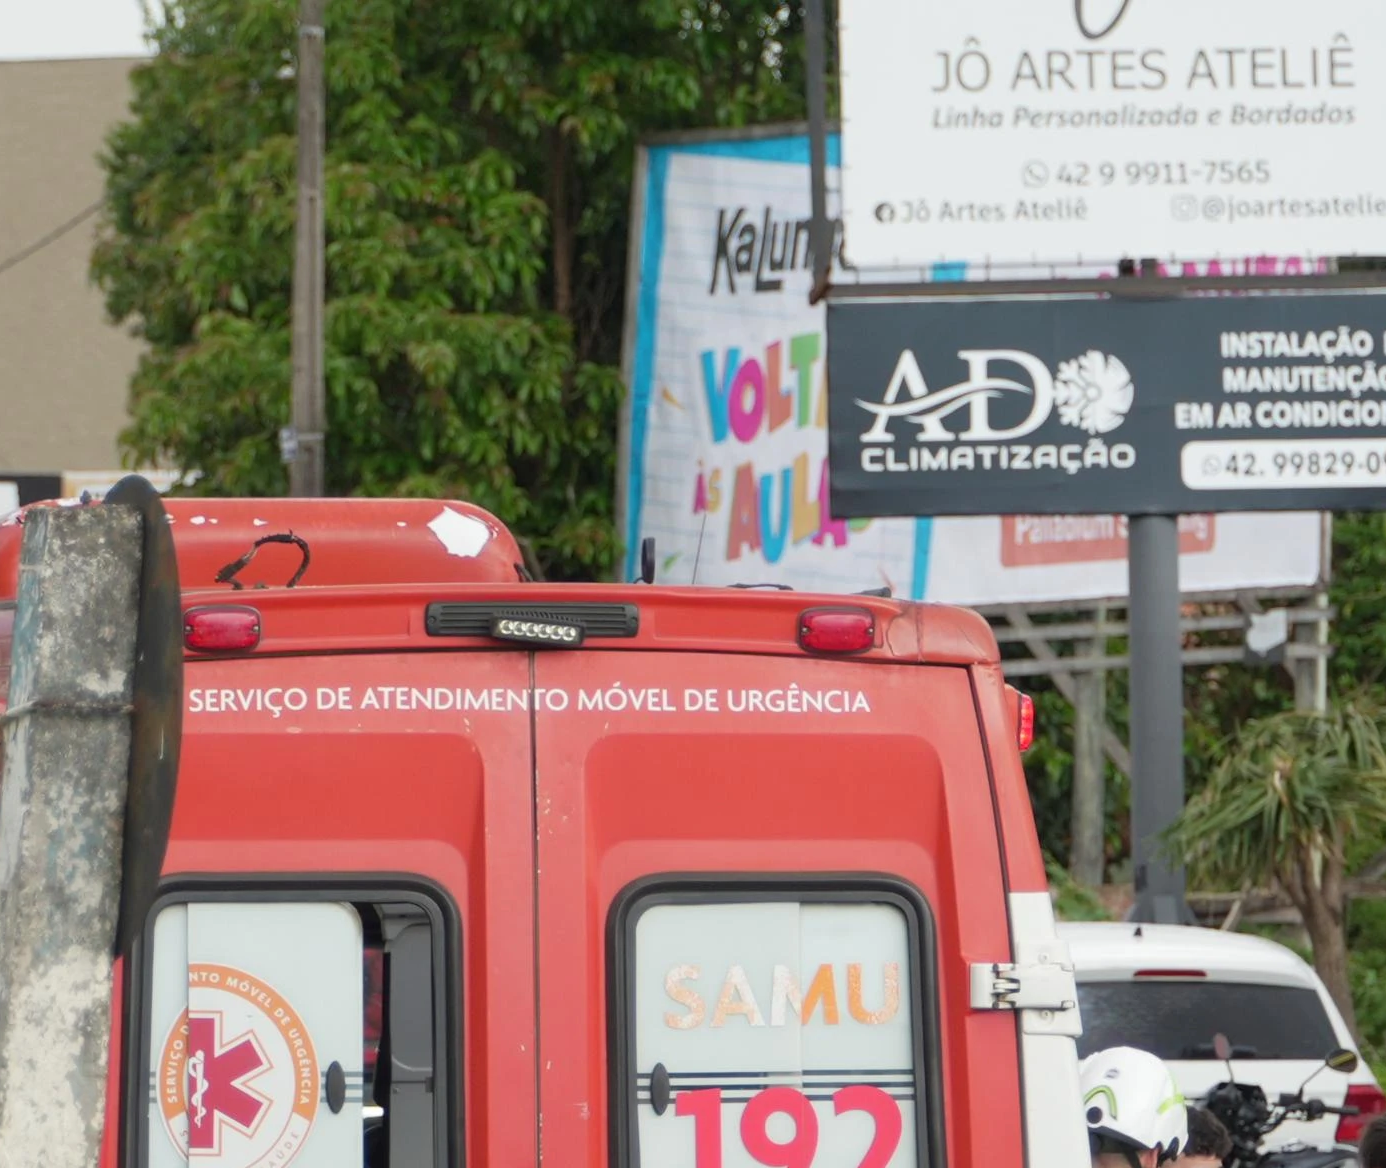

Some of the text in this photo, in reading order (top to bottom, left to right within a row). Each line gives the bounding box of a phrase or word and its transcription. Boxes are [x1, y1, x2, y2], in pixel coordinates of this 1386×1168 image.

[932, 33, 1356, 92] JÔ ARTES ATELIÊ
[932, 102, 1356, 130] Linha Personalizada e Bordados
[1056, 161, 1270, 185] 42 9 9911-7565
[939, 199, 1006, 222] Artes
[1013, 198, 1088, 221] Ateliê
[1220, 326, 1373, 361] INSTALAÇÃO
[1175, 403, 1211, 429] EM
[1216, 403, 1252, 428] AR
[861, 438, 1136, 475] CLIMATIZAÇÃO
[1224, 453, 1267, 476] 42.
[725, 452, 873, 562] AULA
[189, 681, 871, 718] SERVIÇO DE ATENDIMENTO MÓVEL DE URGÊNCIA
[662, 962, 898, 1030] SAMU
[225, 972, 311, 1105] MÓVEL DE URGÊNCIA
[166, 1041, 183, 1104] SERVIÇO
